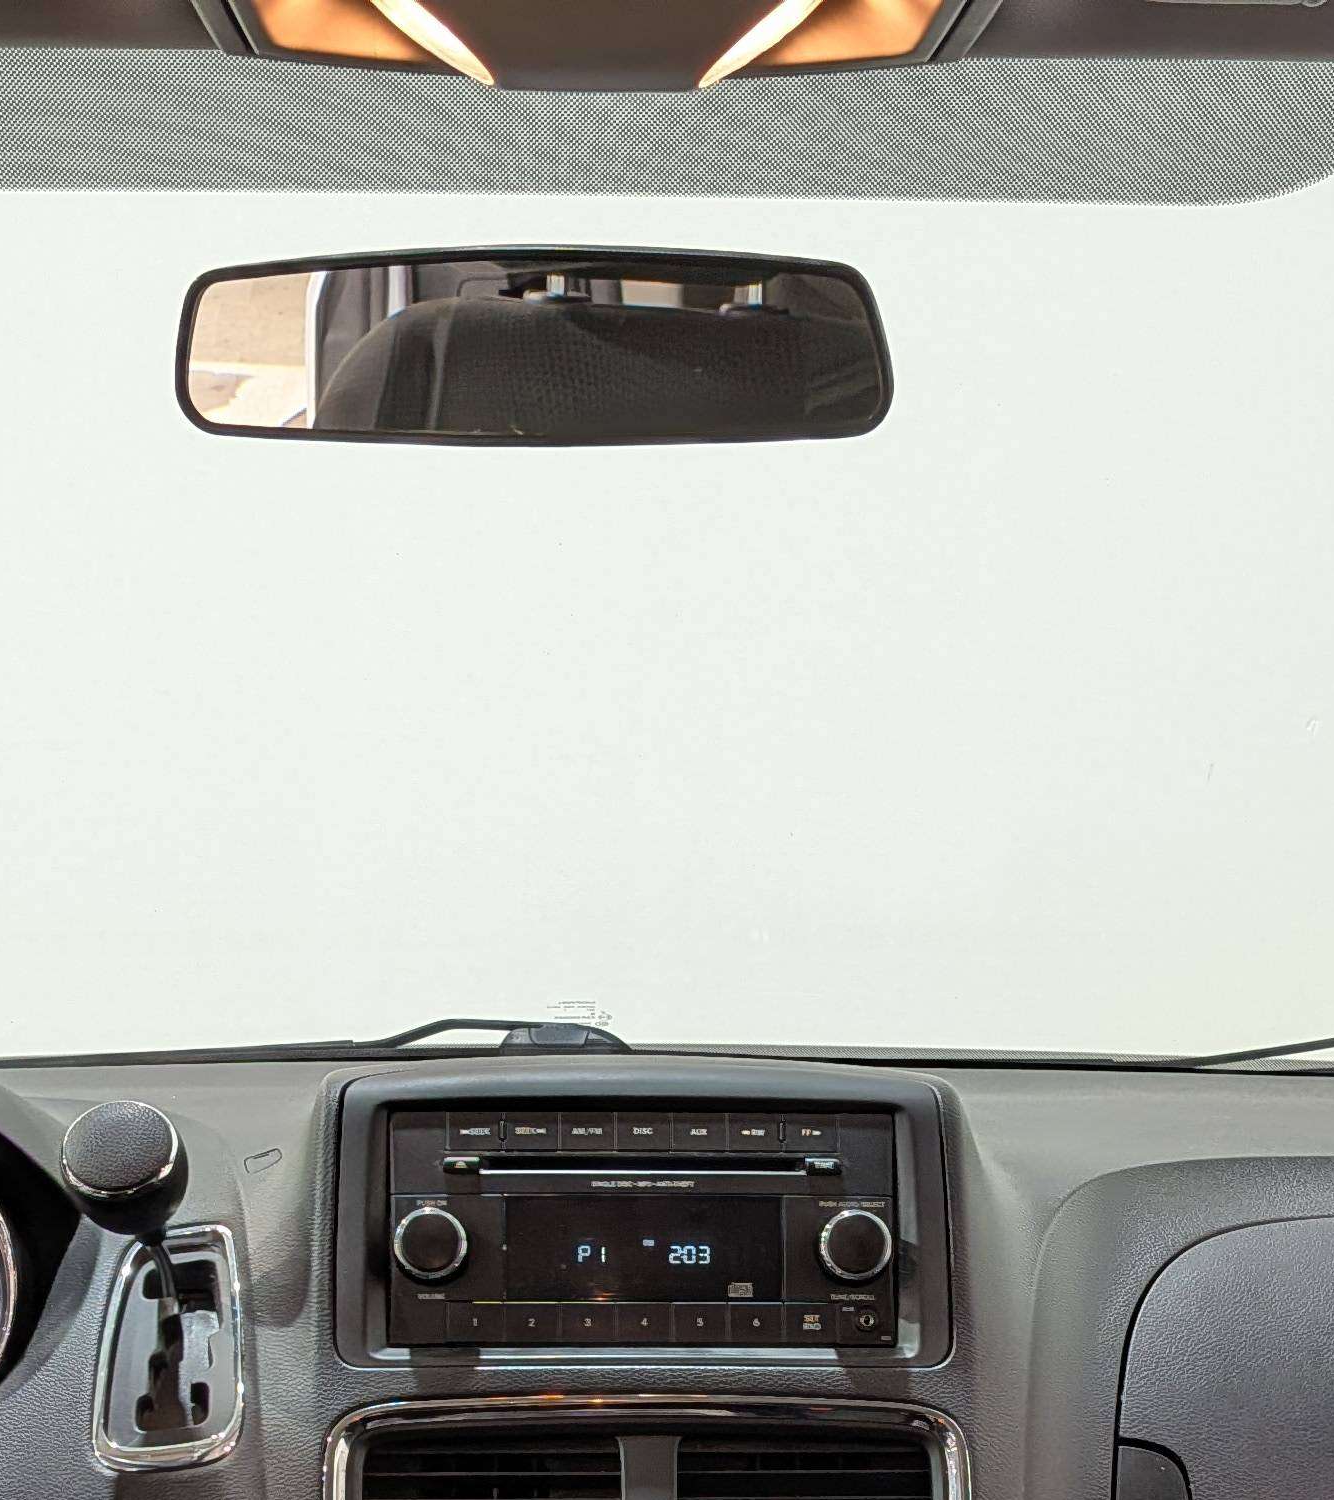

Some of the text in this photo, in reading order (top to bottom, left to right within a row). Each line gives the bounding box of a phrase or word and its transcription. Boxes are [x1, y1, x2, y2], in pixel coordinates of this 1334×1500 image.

[633, 1127, 653, 1135] DISC
[669, 1246, 710, 1264] 203
[473, 1318, 478, 1326] 1
[528, 1318, 535, 1326] 2
[584, 1318, 591, 1326] 3
[641, 1318, 648, 1326] 4
[697, 1318, 704, 1326] 5
[753, 1318, 760, 1326] 6
